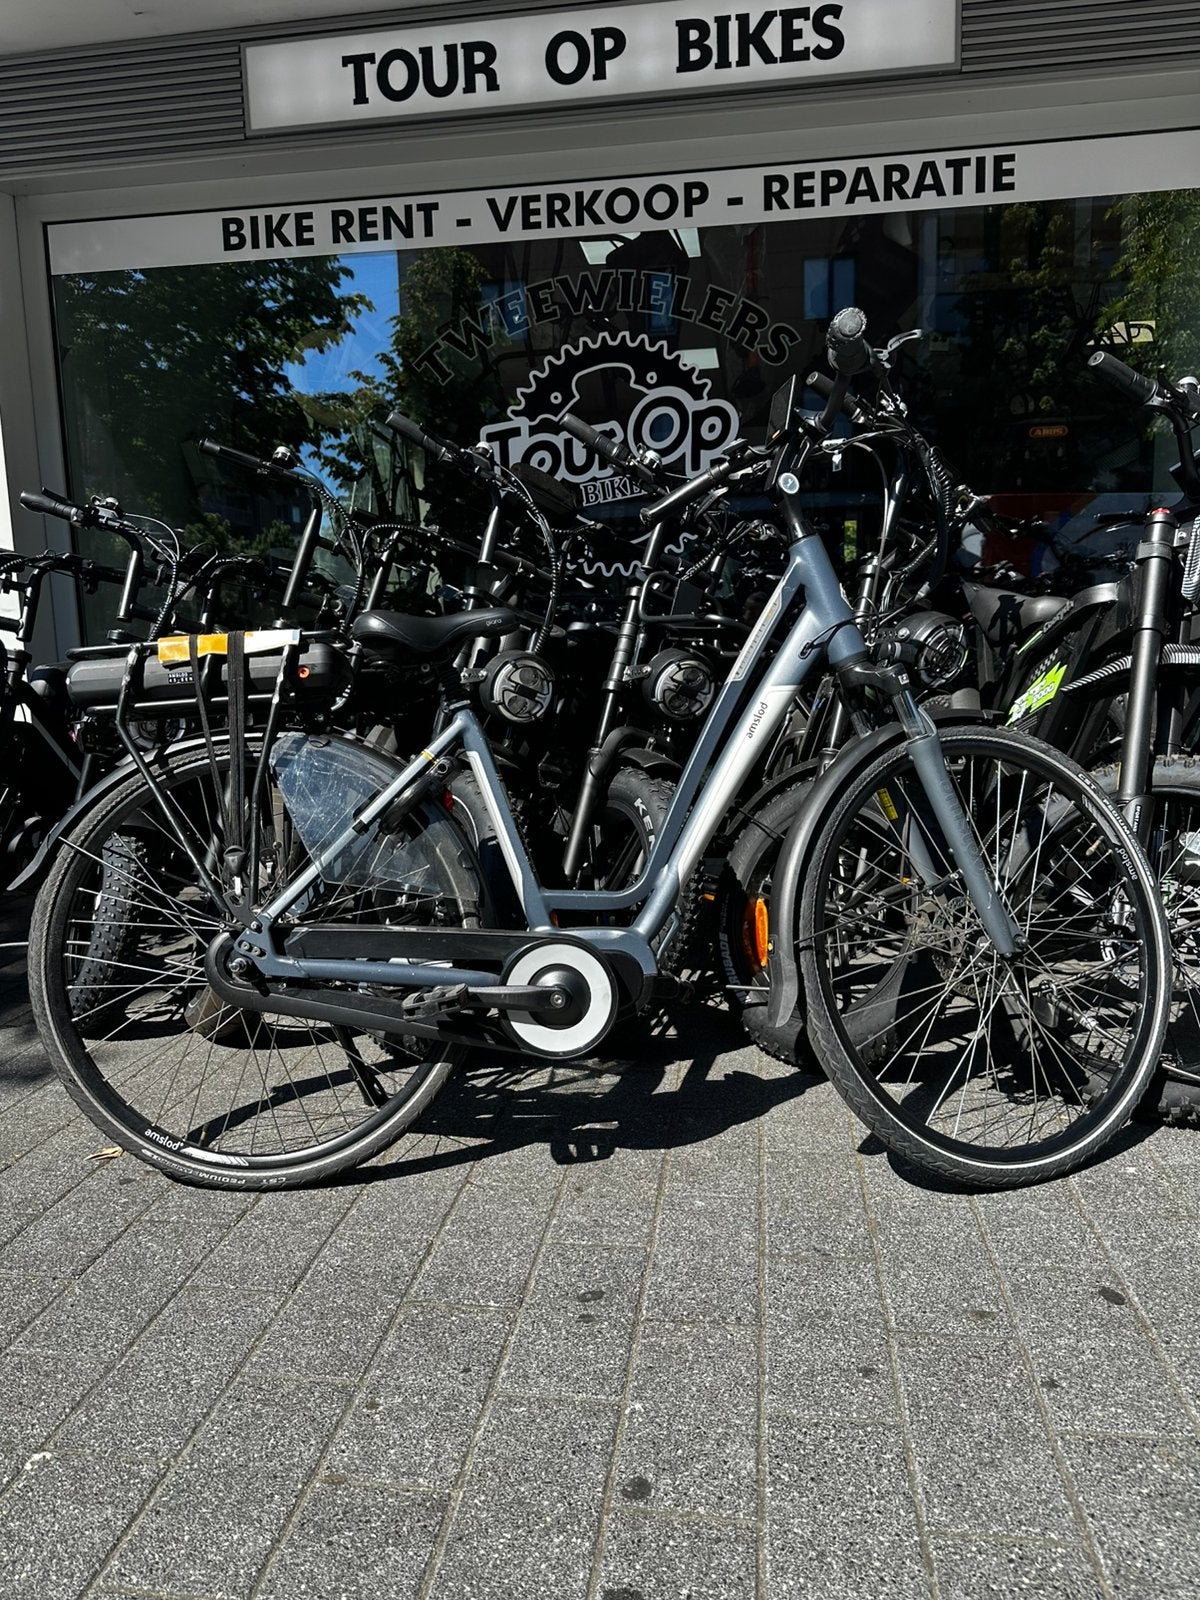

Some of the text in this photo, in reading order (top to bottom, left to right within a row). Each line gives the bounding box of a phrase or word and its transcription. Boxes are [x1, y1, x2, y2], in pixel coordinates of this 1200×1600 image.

[341, 3, 845, 105] TOUR OP BIKES
[221, 153, 1016, 252] BIKE RENT - VERKOOP - REPARATIE
[412, 269, 801, 386] TWEEWIELERS
[746, 701, 768, 739] amslod
[1078, 773, 1097, 790] CST
[144, 1128, 182, 1151] amslod
